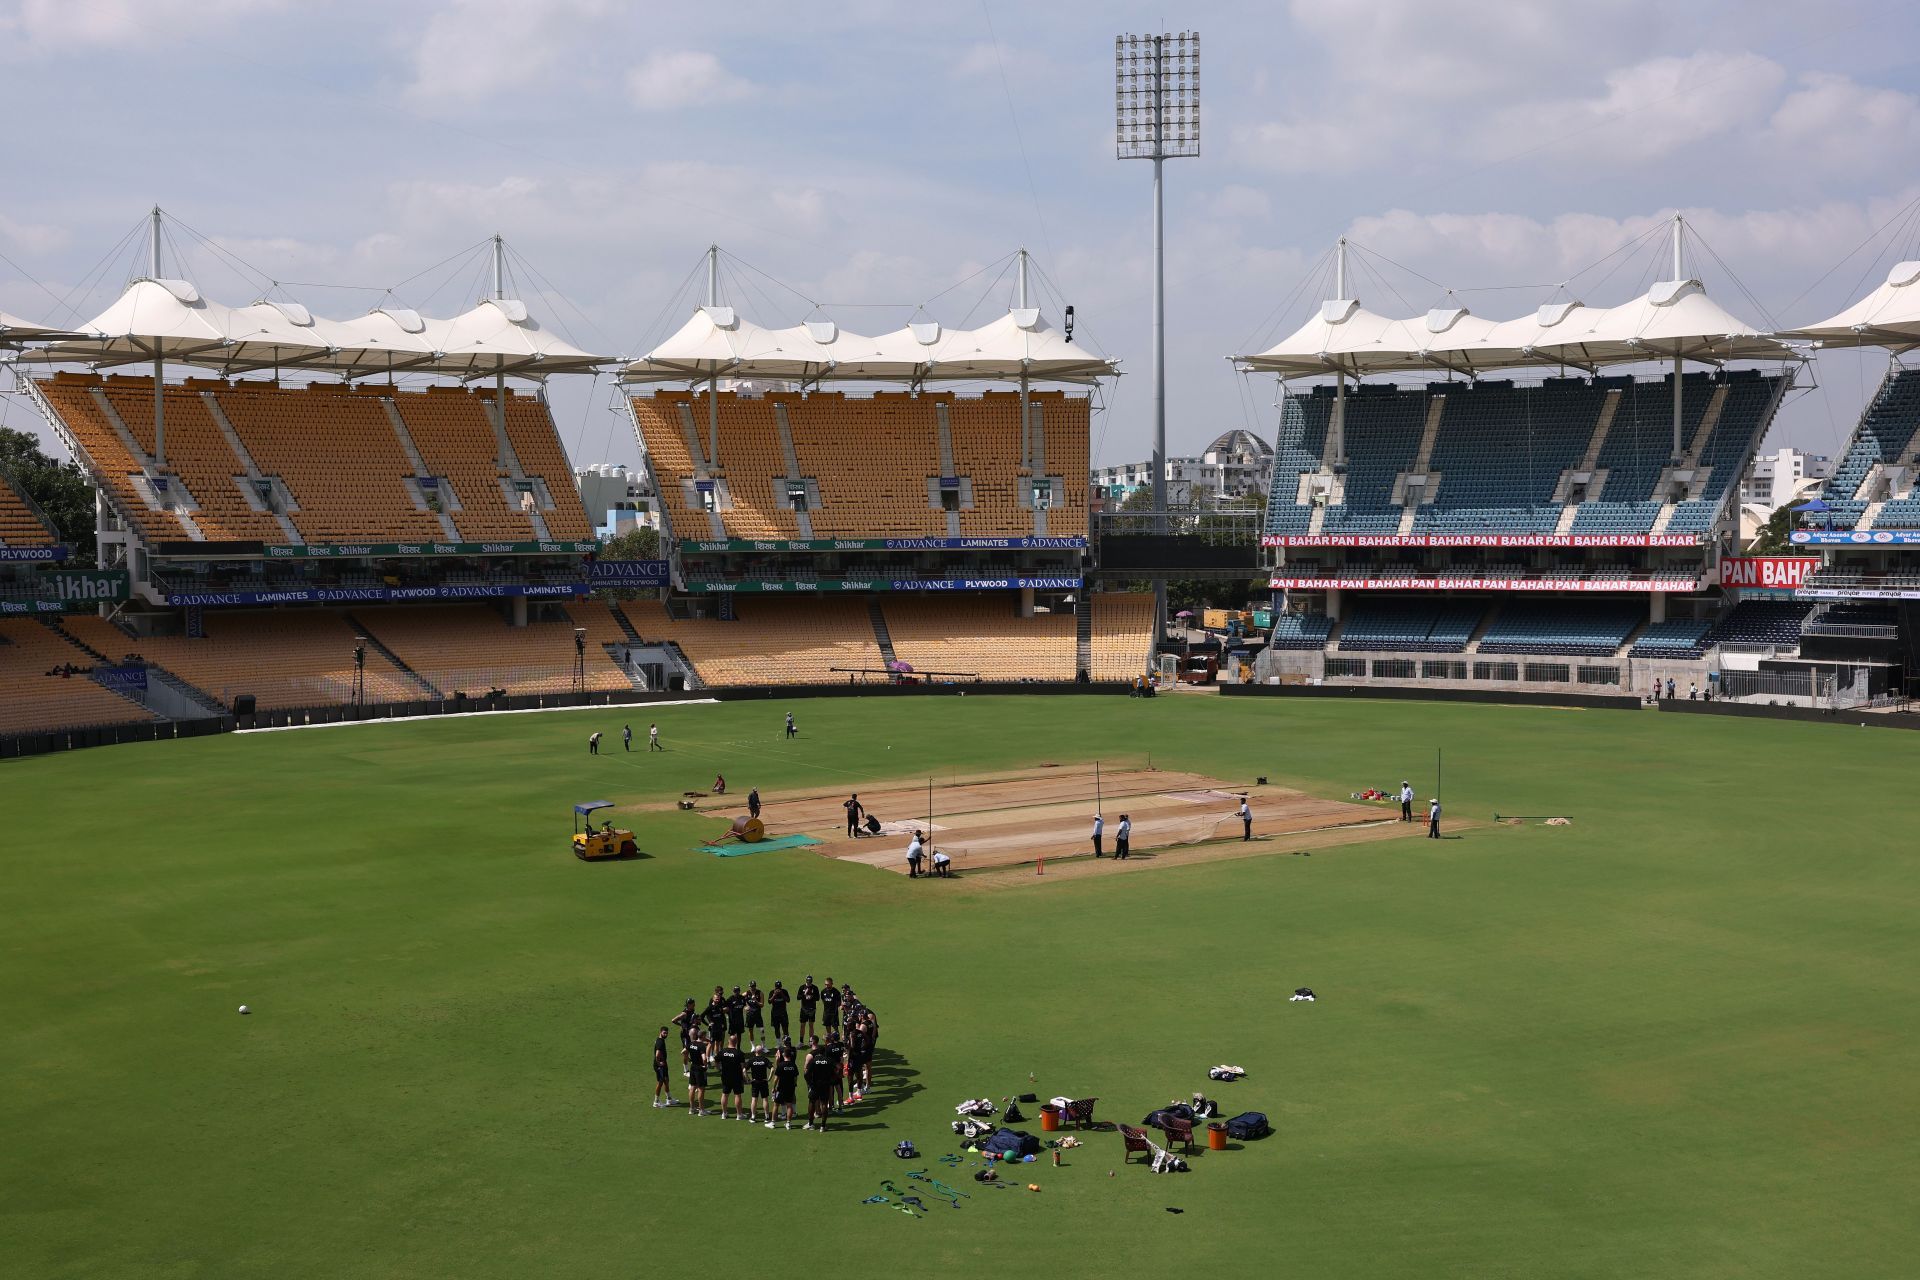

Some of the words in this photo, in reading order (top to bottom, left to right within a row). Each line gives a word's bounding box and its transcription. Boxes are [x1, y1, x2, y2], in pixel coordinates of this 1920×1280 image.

[834, 541, 865, 549] Shikhar
[896, 540, 946, 548] ADVANCE
[1031, 539, 1082, 547] ADVANCE
[1262, 537, 1284, 545] PAN
[1289, 537, 1329, 545] BAHAR
[1332, 537, 1355, 545] PAN
[1359, 537, 1399, 545] BAHAR
[1402, 537, 1425, 545] PAN
[1430, 537, 1471, 545] BAHAR
[1474, 537, 1497, 545] PAN
[1502, 537, 1543, 545] BAHAR
[1546, 537, 1570, 545] PAN
[1574, 537, 1617, 545] BAHAR
[1620, 537, 1645, 545] PAN
[1650, 537, 1694, 545] BAHAR
[338, 546, 371, 554] Shikhar
[482, 544, 513, 552] Shikhar
[700, 542, 731, 550] Shikhar
[1, 550, 52, 558] PLYWOOD
[592, 564, 667, 576] ADVANCE
[1722, 561, 1756, 583] PAN
[40, 575, 122, 599] hikhar
[706, 583, 736, 591] Shikhar
[903, 581, 954, 589] ADVANCE
[1027, 579, 1079, 587] ADVANCE
[1272, 580, 1293, 588] PAN
[1298, 580, 1338, 588] BAHAR
[1341, 580, 1363, 588] PAN
[1368, 580, 1409, 588] BAHAR
[1411, 580, 1434, 588] PAN
[1439, 580, 1480, 588] BAHAR
[1483, 581, 1506, 589] PAN
[1511, 581, 1552, 589] BAHAR
[1556, 581, 1580, 589] PAN
[1584, 581, 1627, 589] BAHAR
[1630, 581, 1651, 589] PAN
[1655, 581, 1692, 589] BAHAR
[327, 590, 382, 599] ADVANCE
[391, 588, 436, 597] PLYWOOD
[451, 587, 504, 595] ADVANCE
[523, 586, 572, 594] LAMINATES
[183, 594, 241, 604] ADVANCE
[256, 592, 308, 601] LAMINATES
